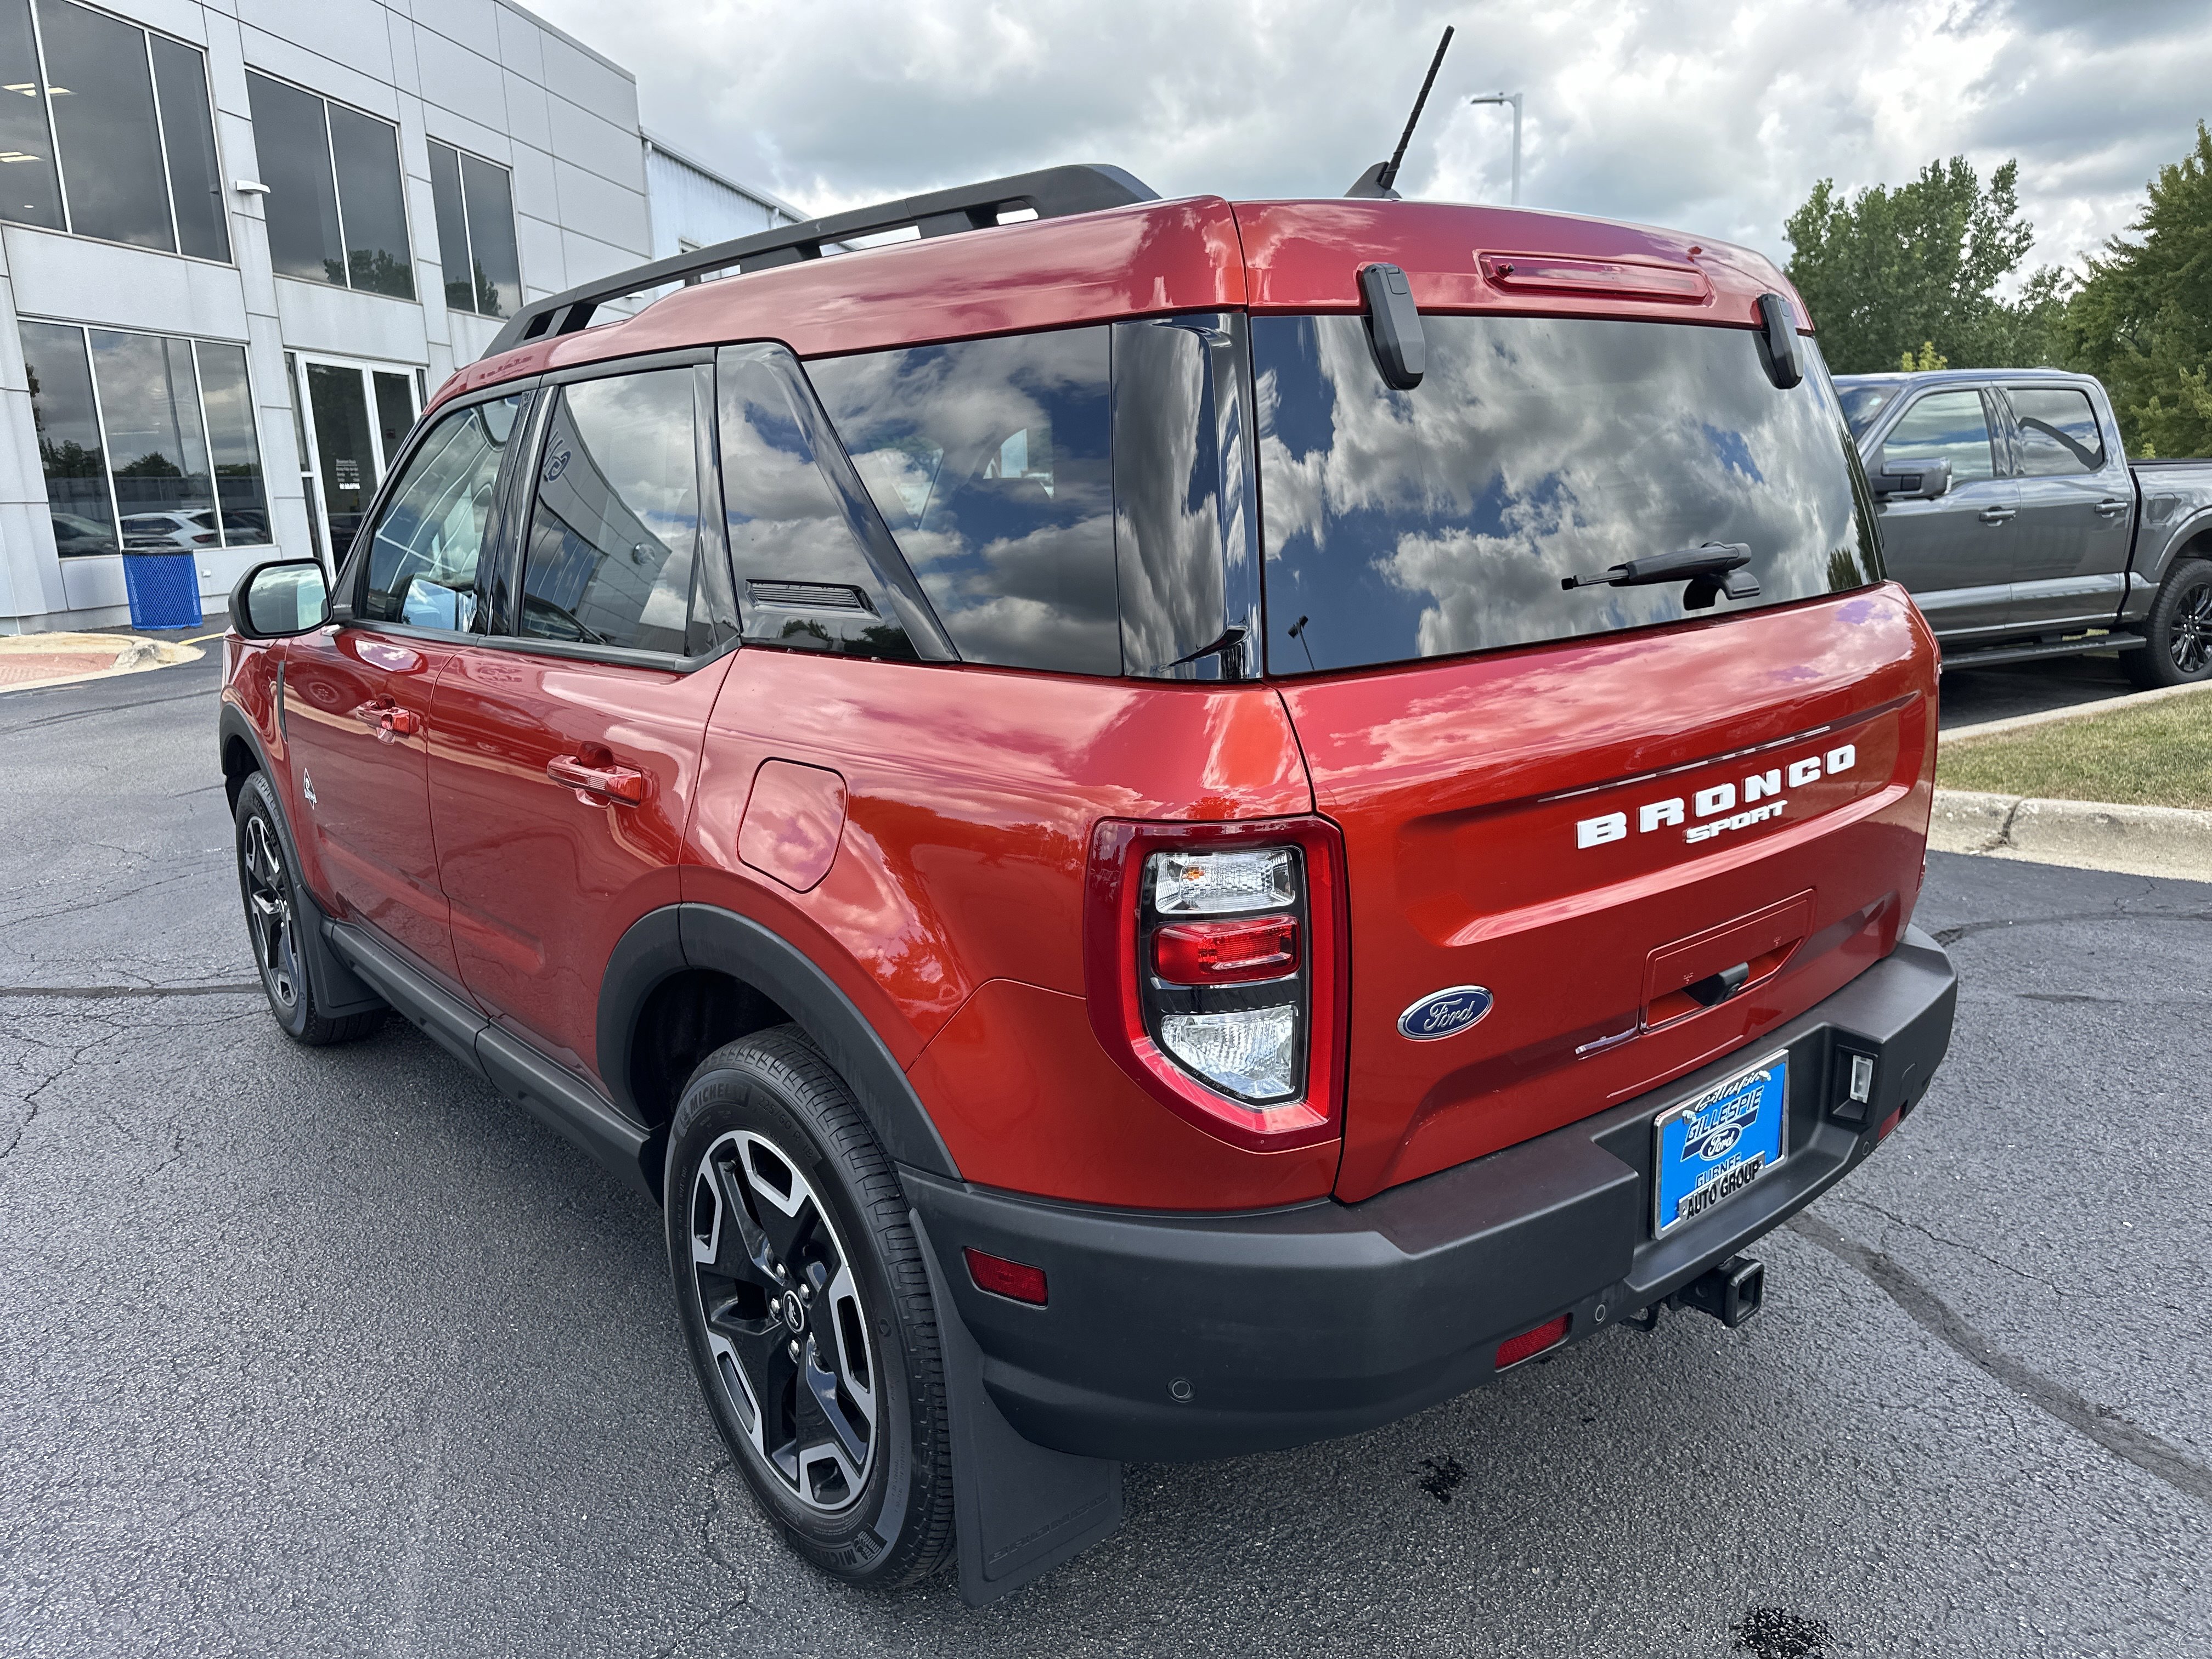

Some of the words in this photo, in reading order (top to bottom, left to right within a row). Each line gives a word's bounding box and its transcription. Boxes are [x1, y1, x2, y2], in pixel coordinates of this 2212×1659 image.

[253, 795, 277, 847] MICHELIN
[1576, 743, 1855, 849] BRONCO
[1685, 800, 1788, 844] SPORT
[1423, 997, 1475, 1032] Ford
[689, 1082, 749, 1114] MICHELIN
[1685, 1085, 1764, 1144] GILLESPIE
[758, 1096, 792, 1130] 225/60
[792, 1131, 801, 1142] R
[802, 1144, 814, 1159] 18
[1708, 1130, 1736, 1156] Ford
[1686, 1182, 1717, 1220] AUTO
[1720, 1158, 1759, 1198] GROUP
